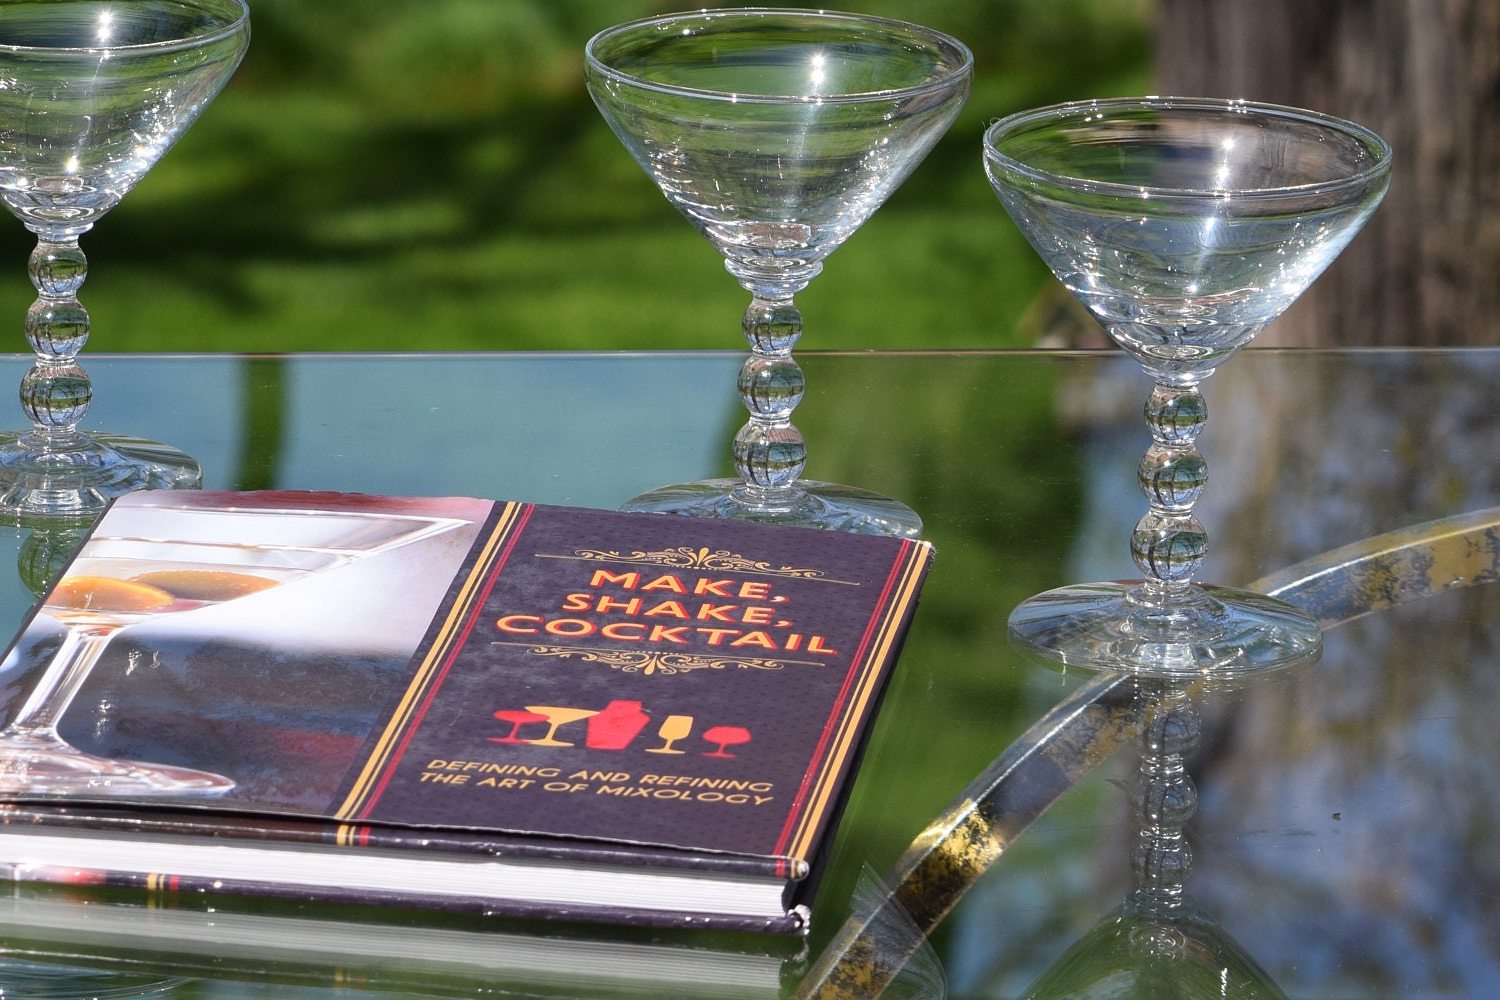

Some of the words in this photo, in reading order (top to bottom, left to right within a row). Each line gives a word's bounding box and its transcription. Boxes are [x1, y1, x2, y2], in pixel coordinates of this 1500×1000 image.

[590, 569, 790, 602] MAKE,
[562, 593, 794, 628] SHAKE,
[496, 615, 838, 655] COCKTAIL
[420, 772, 470, 785] THE
[476, 777, 535, 790] ART
[544, 781, 589, 795] OF
[596, 785, 773, 806] MIXOLOGY
[427, 759, 562, 778] DEFINING
[576, 768, 632, 784] AND
[639, 774, 773, 792] REFINING
